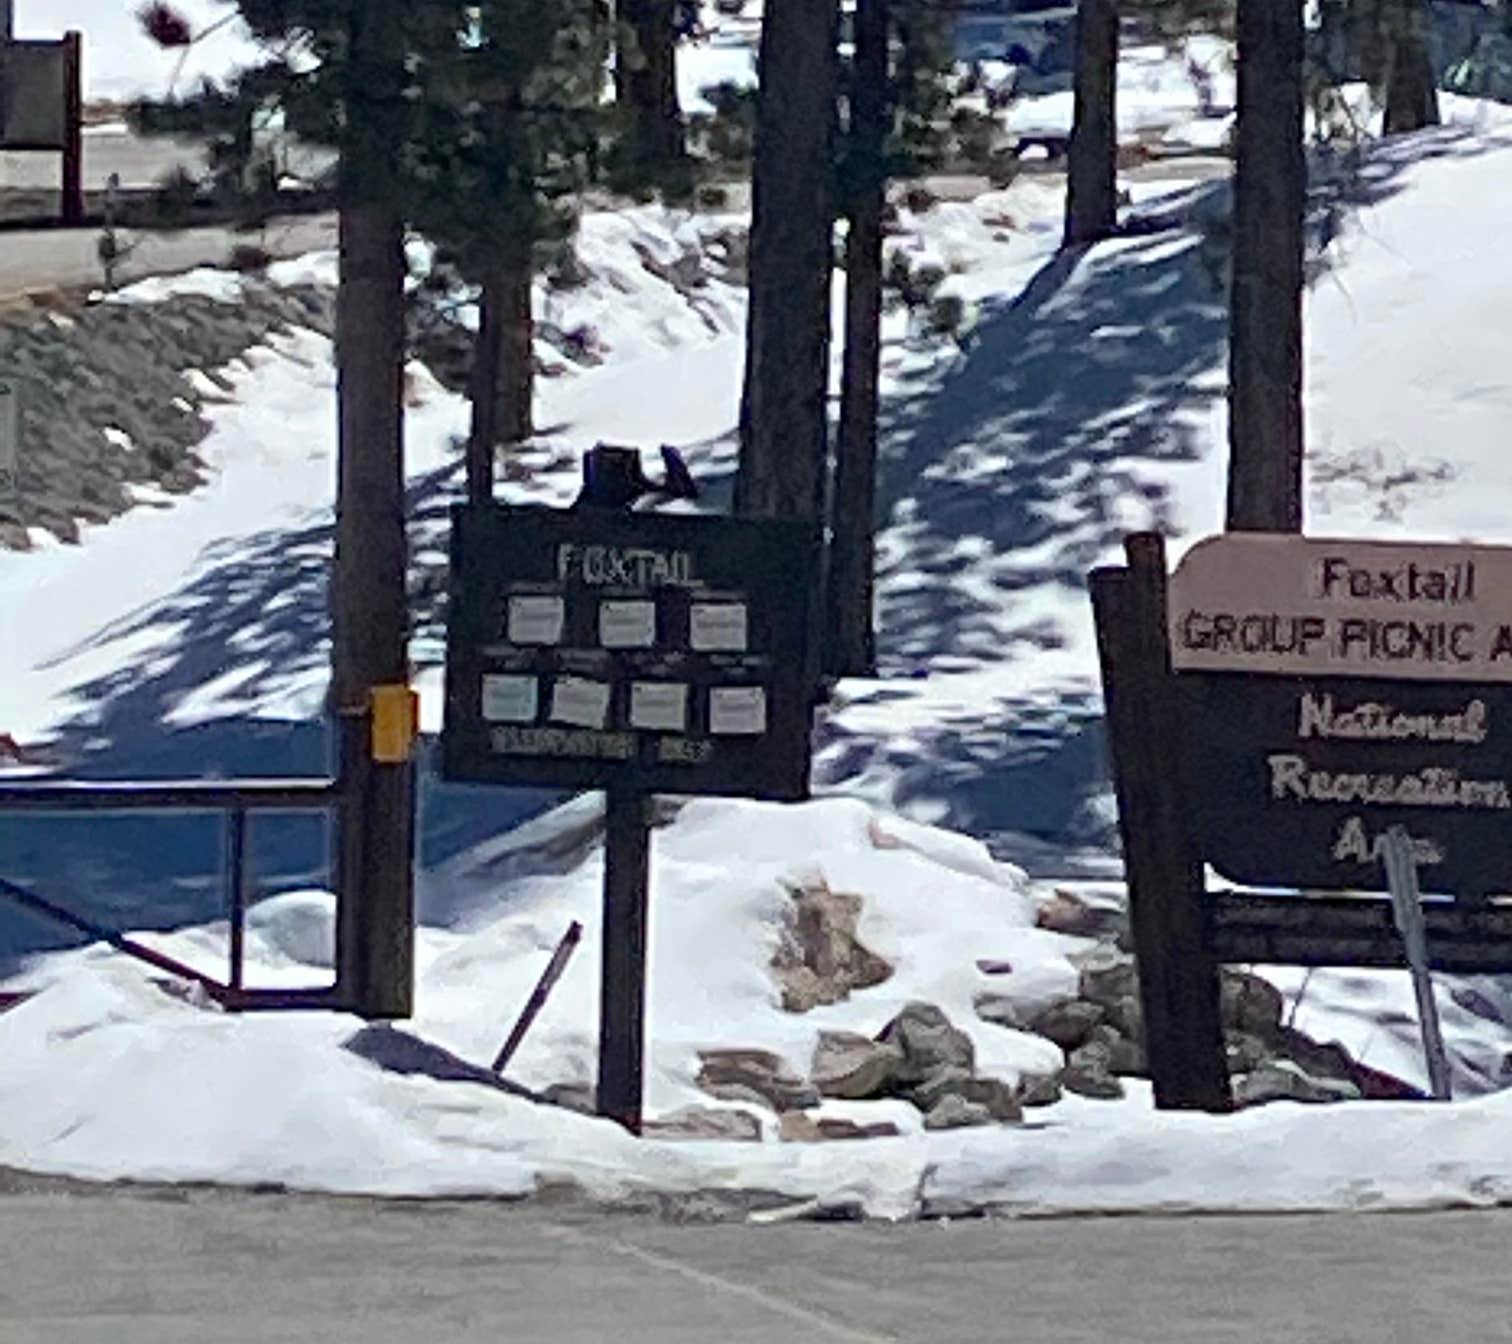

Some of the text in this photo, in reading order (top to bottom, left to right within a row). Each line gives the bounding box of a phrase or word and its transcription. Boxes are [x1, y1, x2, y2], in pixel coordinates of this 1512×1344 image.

[557, 543, 704, 587] FOXTAIL
[1319, 557, 1476, 605] Foxtail
[1181, 609, 1326, 654] GROUP
[1338, 617, 1476, 663] PICNIC
[1298, 692, 1488, 743] National
[1267, 754, 1511, 808] Recreation
